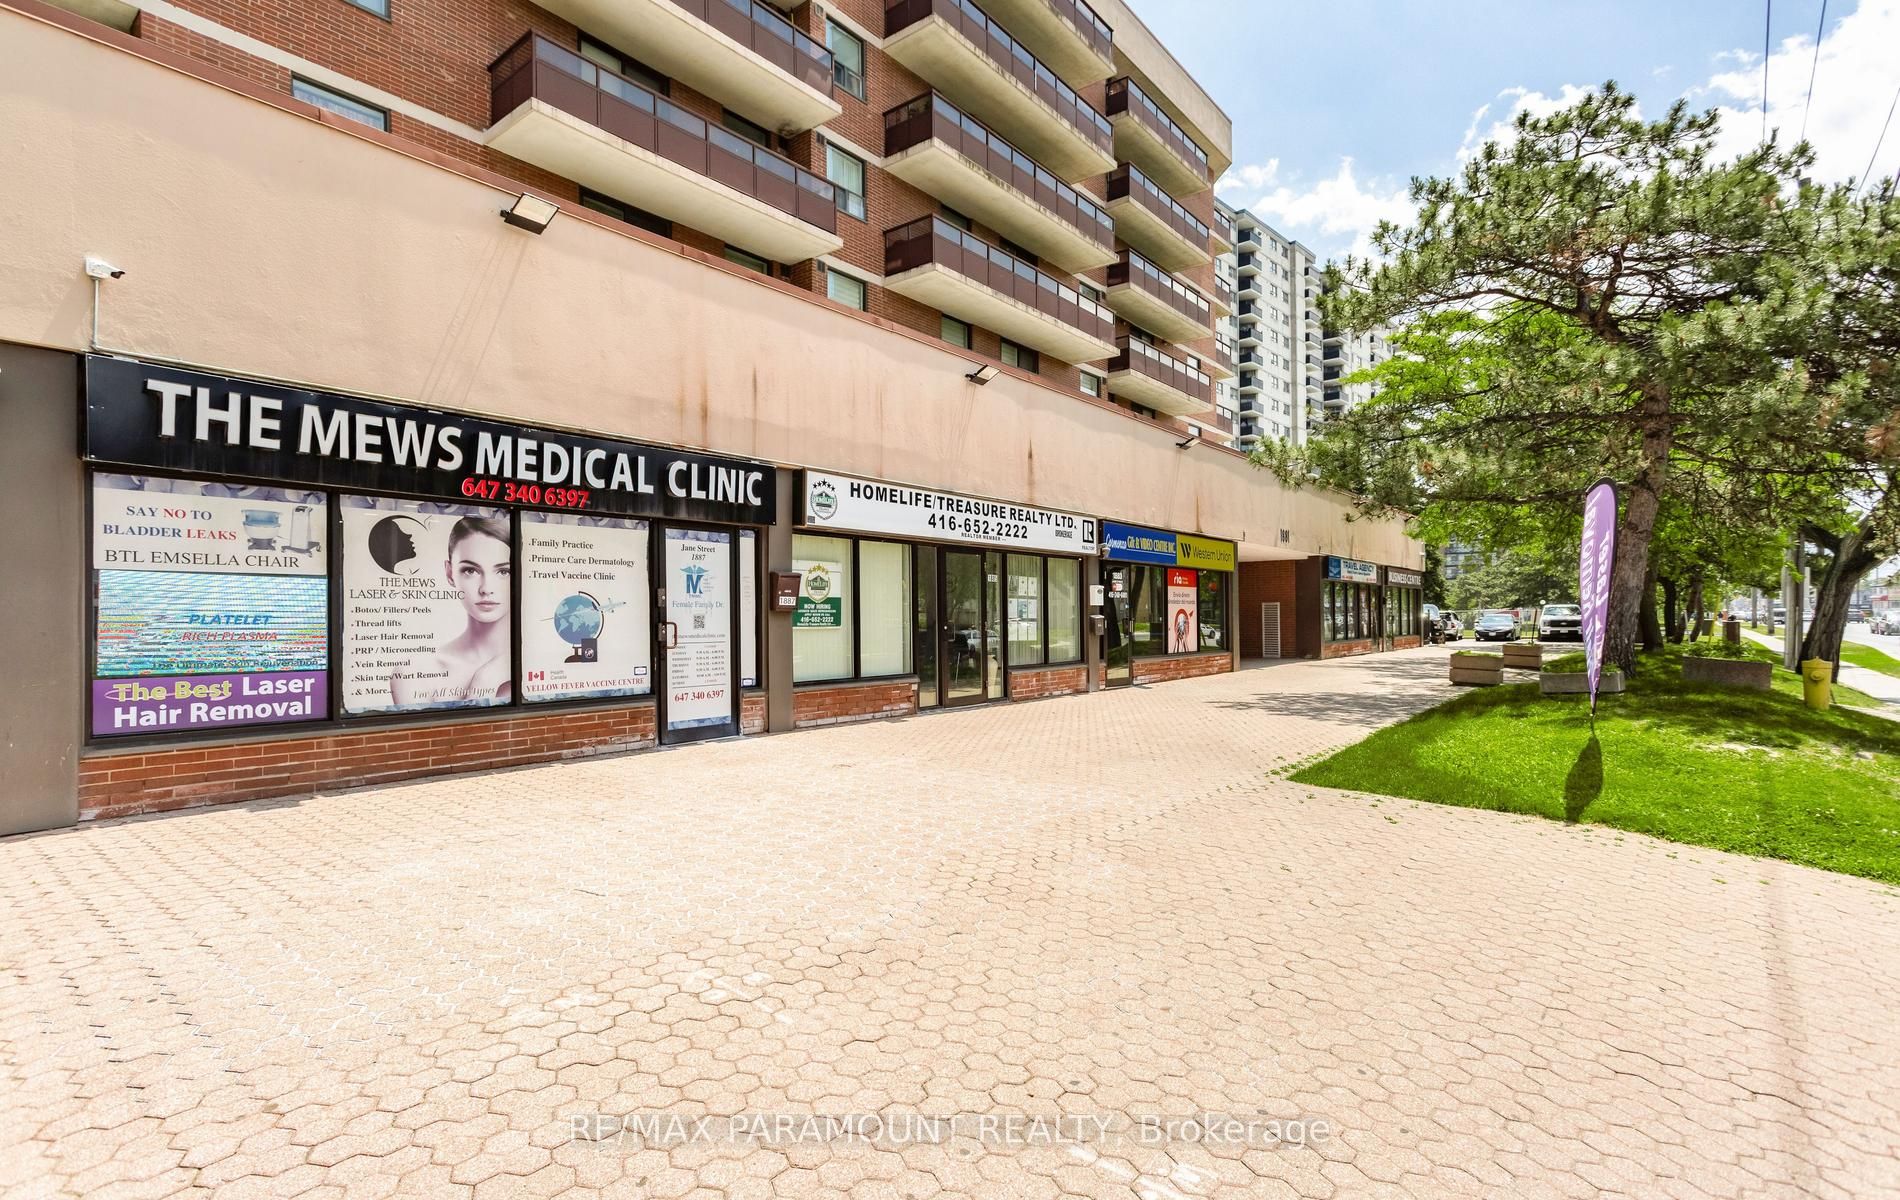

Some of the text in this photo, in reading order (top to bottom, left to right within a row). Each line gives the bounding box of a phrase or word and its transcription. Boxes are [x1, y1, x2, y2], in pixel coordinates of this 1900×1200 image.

[146, 378, 763, 506] THE MEWS MEDICAL CLINIC
[461, 477, 590, 509] 647 340 6397
[850, 482, 1006, 519] HOMELIFE/TREASURE
[1009, 507, 1052, 525] REALTY
[1055, 515, 1077, 530] LTD.
[126, 505, 212, 521] SAY NO TO
[928, 513, 1028, 539] 416-652-2222
[103, 523, 237, 541] BLADDER LEAKS
[562, 540, 594, 550] Practice
[681, 544, 716, 553] Jane Street
[1140, 537, 1153, 551] VIDEO
[105, 549, 300, 568] BTL EMSELLA CHAIR
[691, 553, 706, 561] 1887
[1193, 545, 1216, 560] Western
[1216, 550, 1232, 562] Union
[567, 555, 586, 565] Care
[588, 556, 635, 568] Dermatology
[561, 571, 592, 581] Vaccine
[593, 571, 616, 581] Clinic
[379, 577, 436, 588] THE MEWS
[350, 589, 465, 600] LASER & SKIN CLINIC
[694, 601, 714, 610] Family
[780, 597, 796, 605] 1887
[412, 606, 432, 614] Peels
[188, 614, 273, 625] PLATELET
[387, 619, 402, 627] lifts
[182, 631, 278, 641] RICH PLASMA
[401, 632, 434, 640] Removal
[381, 646, 436, 654] Microneedling
[376, 659, 411, 667] Removal
[416, 670, 449, 679] Removal
[113, 676, 316, 703] The Best Laser
[526, 677, 645, 693] YELLOW FEVER VACCINE CENTRE
[413, 690, 429, 699] For
[432, 688, 446, 698] All
[674, 690, 724, 702] 647 340 6397
[114, 695, 312, 728] Hair Removal
